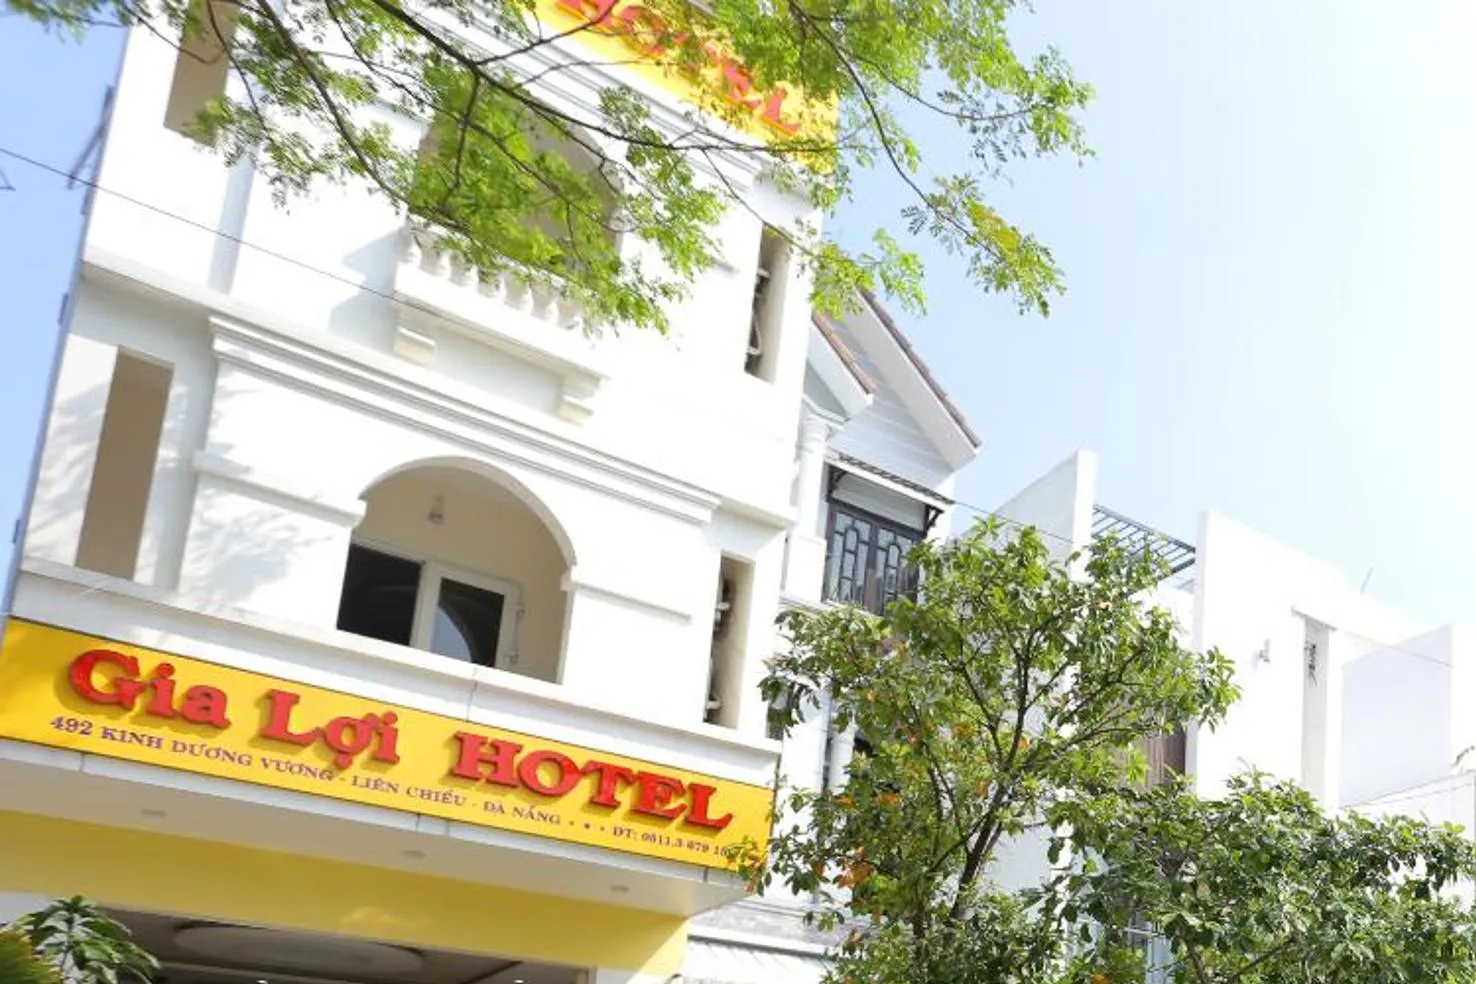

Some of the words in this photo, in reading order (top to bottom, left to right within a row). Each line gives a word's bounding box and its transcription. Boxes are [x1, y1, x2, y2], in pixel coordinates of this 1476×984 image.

[50, 715, 93, 736] 492
[100, 725, 163, 750] KINH
[172, 738, 253, 767] DƯƠNG
[259, 756, 334, 782] VƯƠNG
[352, 775, 400, 793] LIÊN
[70, 649, 231, 729] Gia
[259, 689, 400, 769] Lợi
[449, 730, 733, 830] HOTEL
